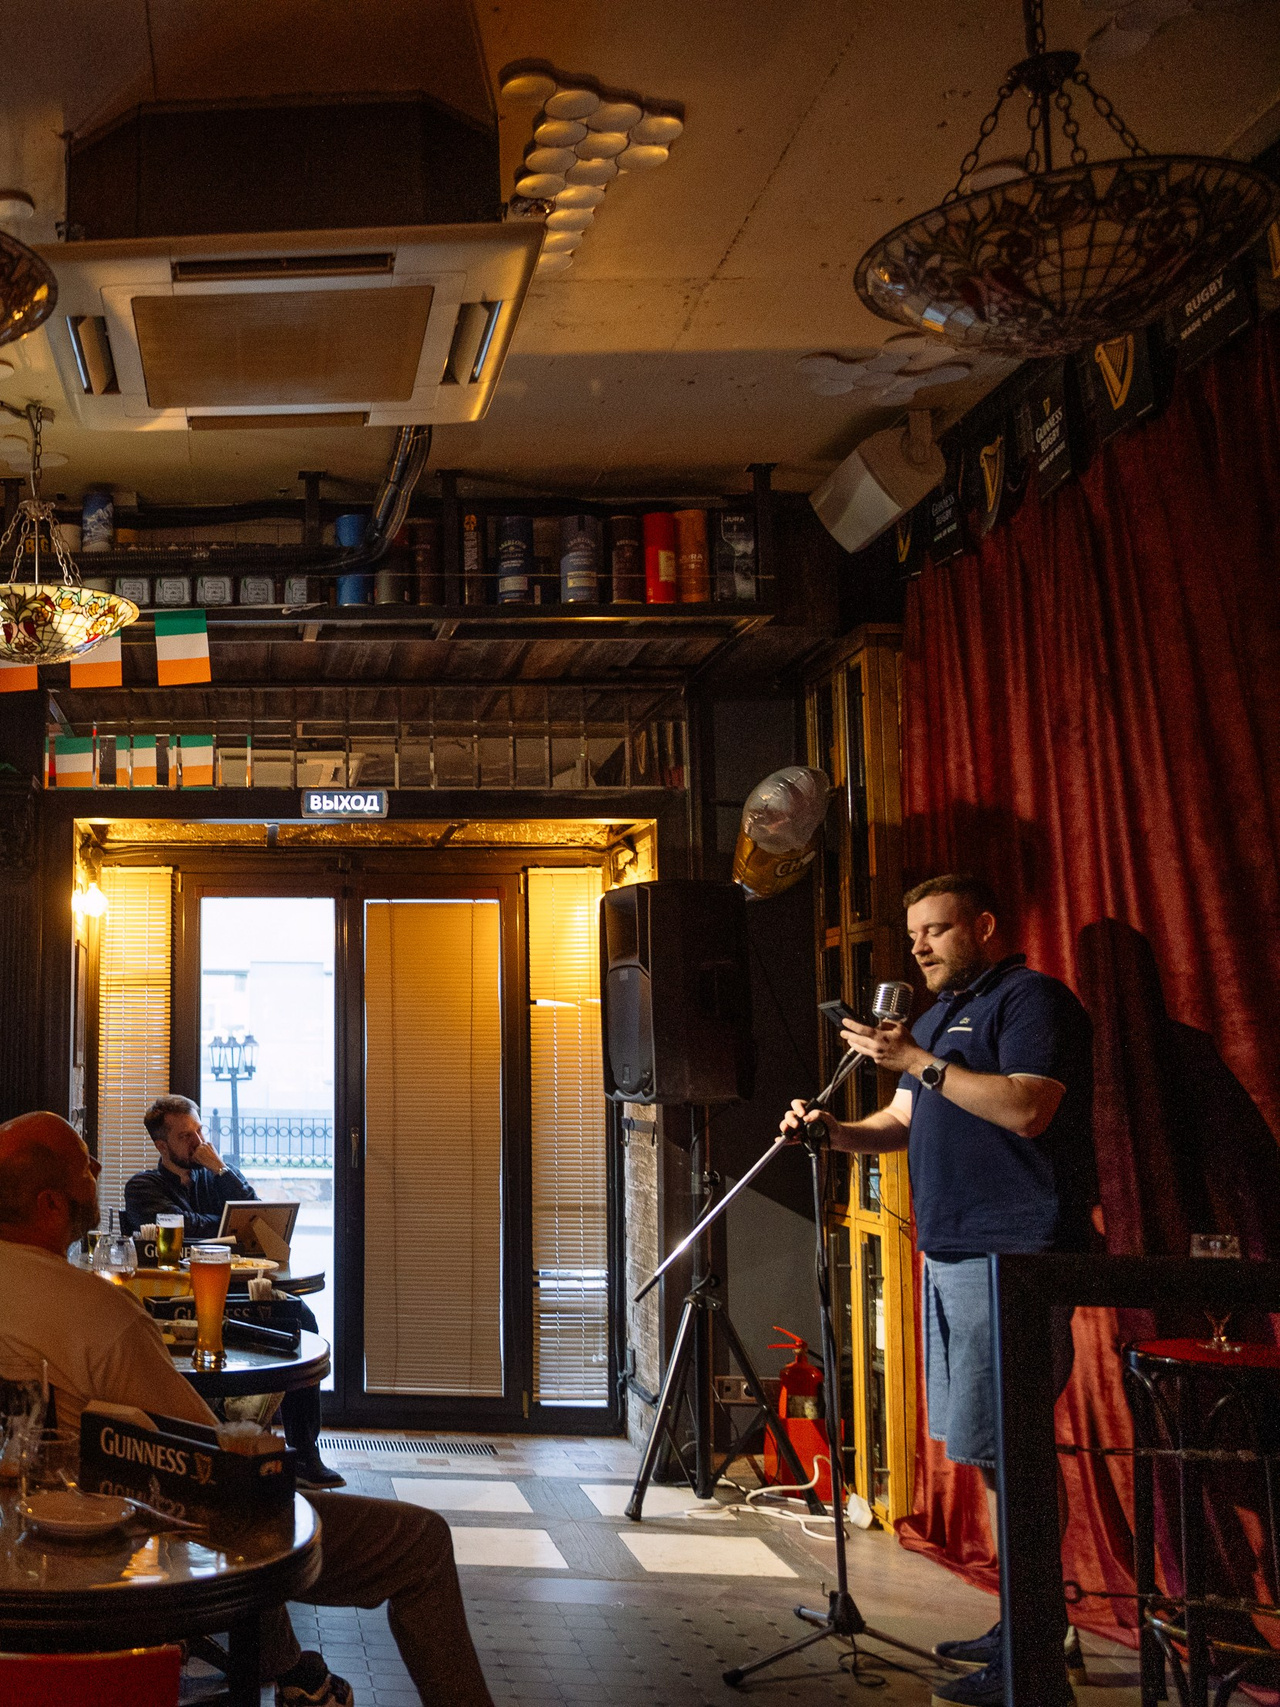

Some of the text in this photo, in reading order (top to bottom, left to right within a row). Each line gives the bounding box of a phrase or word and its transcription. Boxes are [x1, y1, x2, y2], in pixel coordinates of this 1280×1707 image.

[1184, 274, 1224, 318] RUGBY
[310, 794, 380, 811] ВЫХОД
[99, 1426, 188, 1476] GUINNESS
